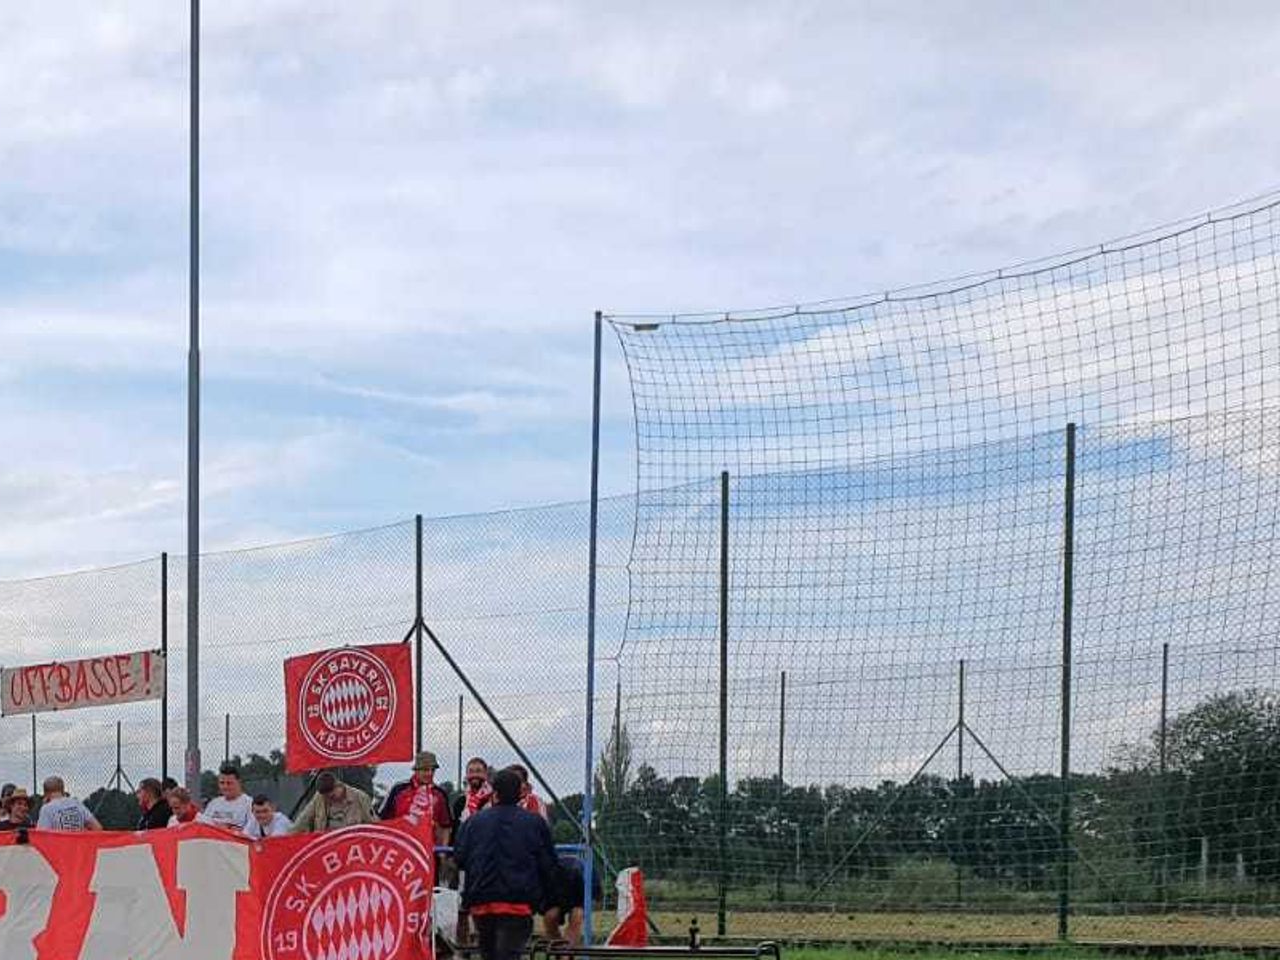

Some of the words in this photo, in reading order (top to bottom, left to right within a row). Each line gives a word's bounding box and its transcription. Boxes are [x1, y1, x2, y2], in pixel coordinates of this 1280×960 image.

[327, 657, 384, 693] BAYERN
[322, 843, 428, 902] BAYERN
[274, 930, 298, 951] 19
